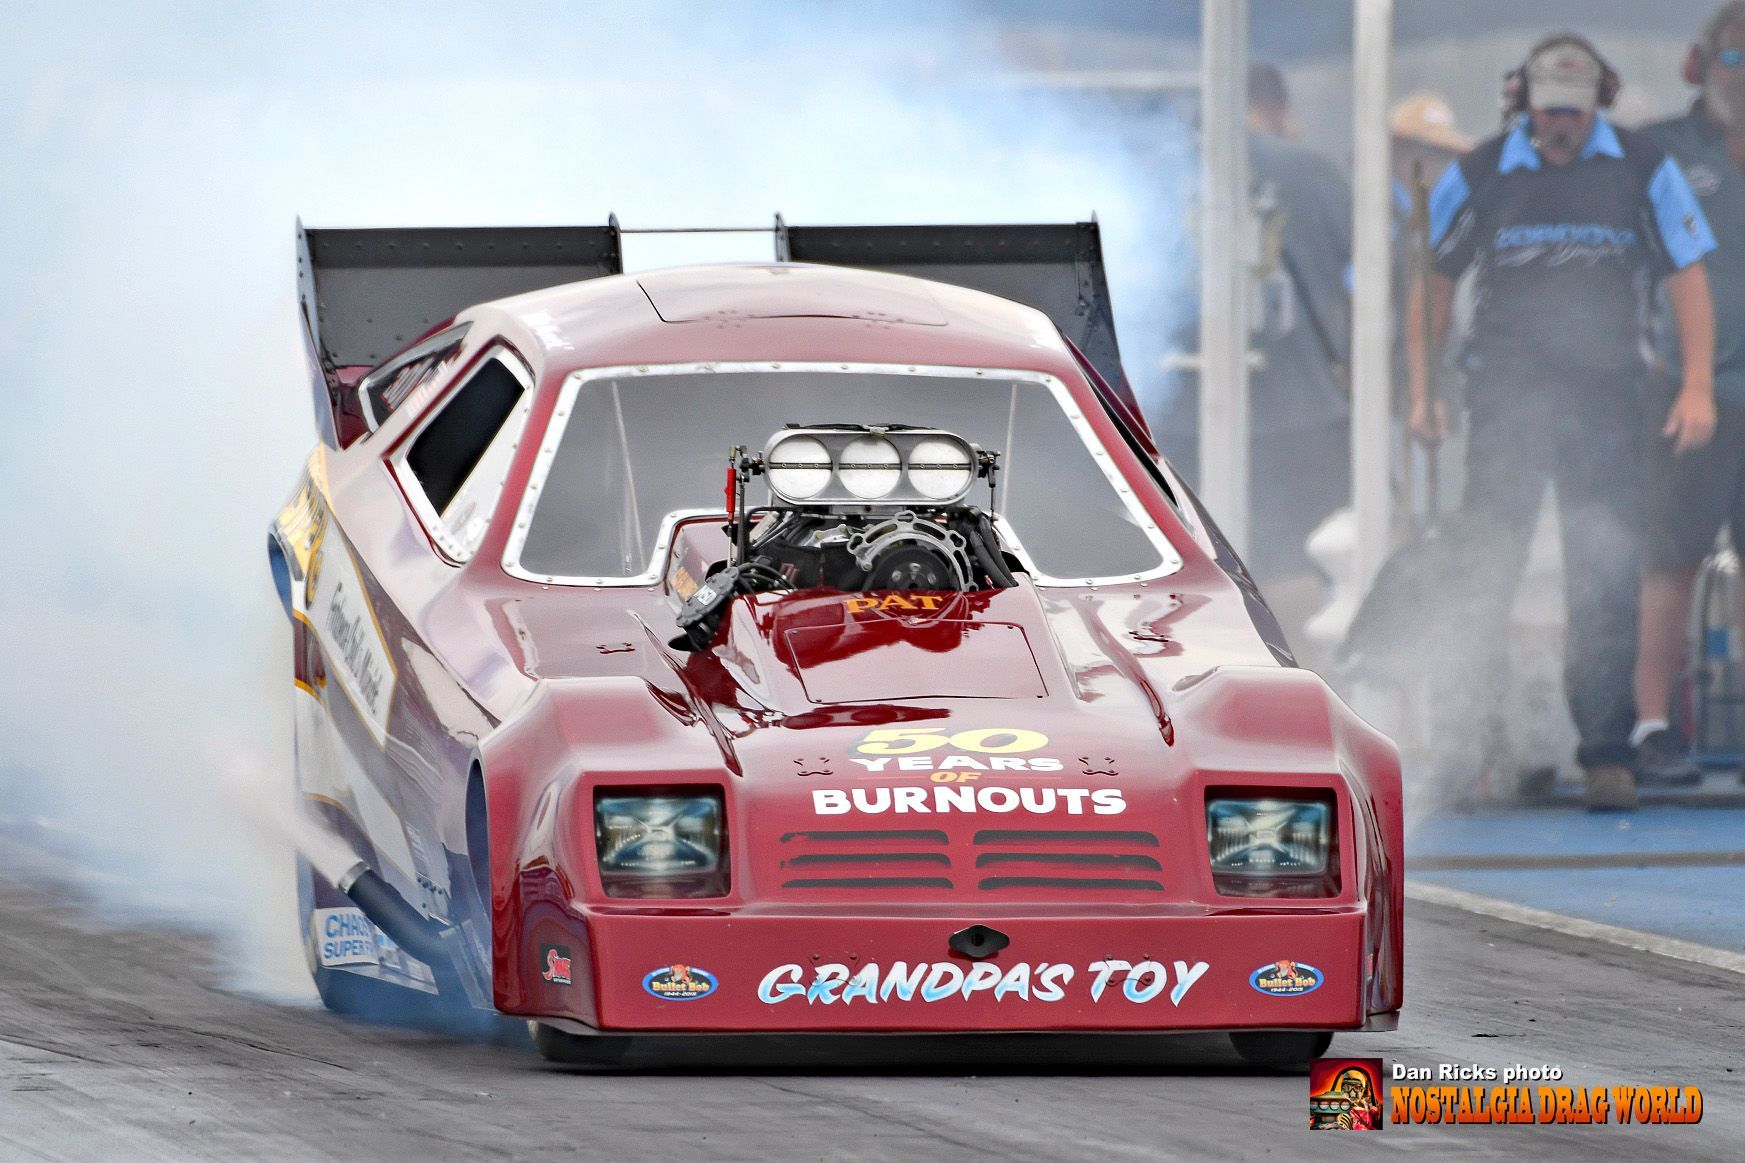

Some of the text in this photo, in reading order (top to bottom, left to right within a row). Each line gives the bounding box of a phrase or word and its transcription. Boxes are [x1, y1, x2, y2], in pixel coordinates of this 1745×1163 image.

[843, 594, 943, 613] PAT
[854, 728, 1049, 755] 50
[850, 755, 1064, 772] YEARS
[929, 771, 983, 783] OF
[811, 786, 1127, 815] BURNOUTS
[652, 981, 710, 991] Bullet Bob
[757, 959, 1210, 1007] GRANDPA'S TOY
[1259, 977, 1316, 987] Bullet Bob
